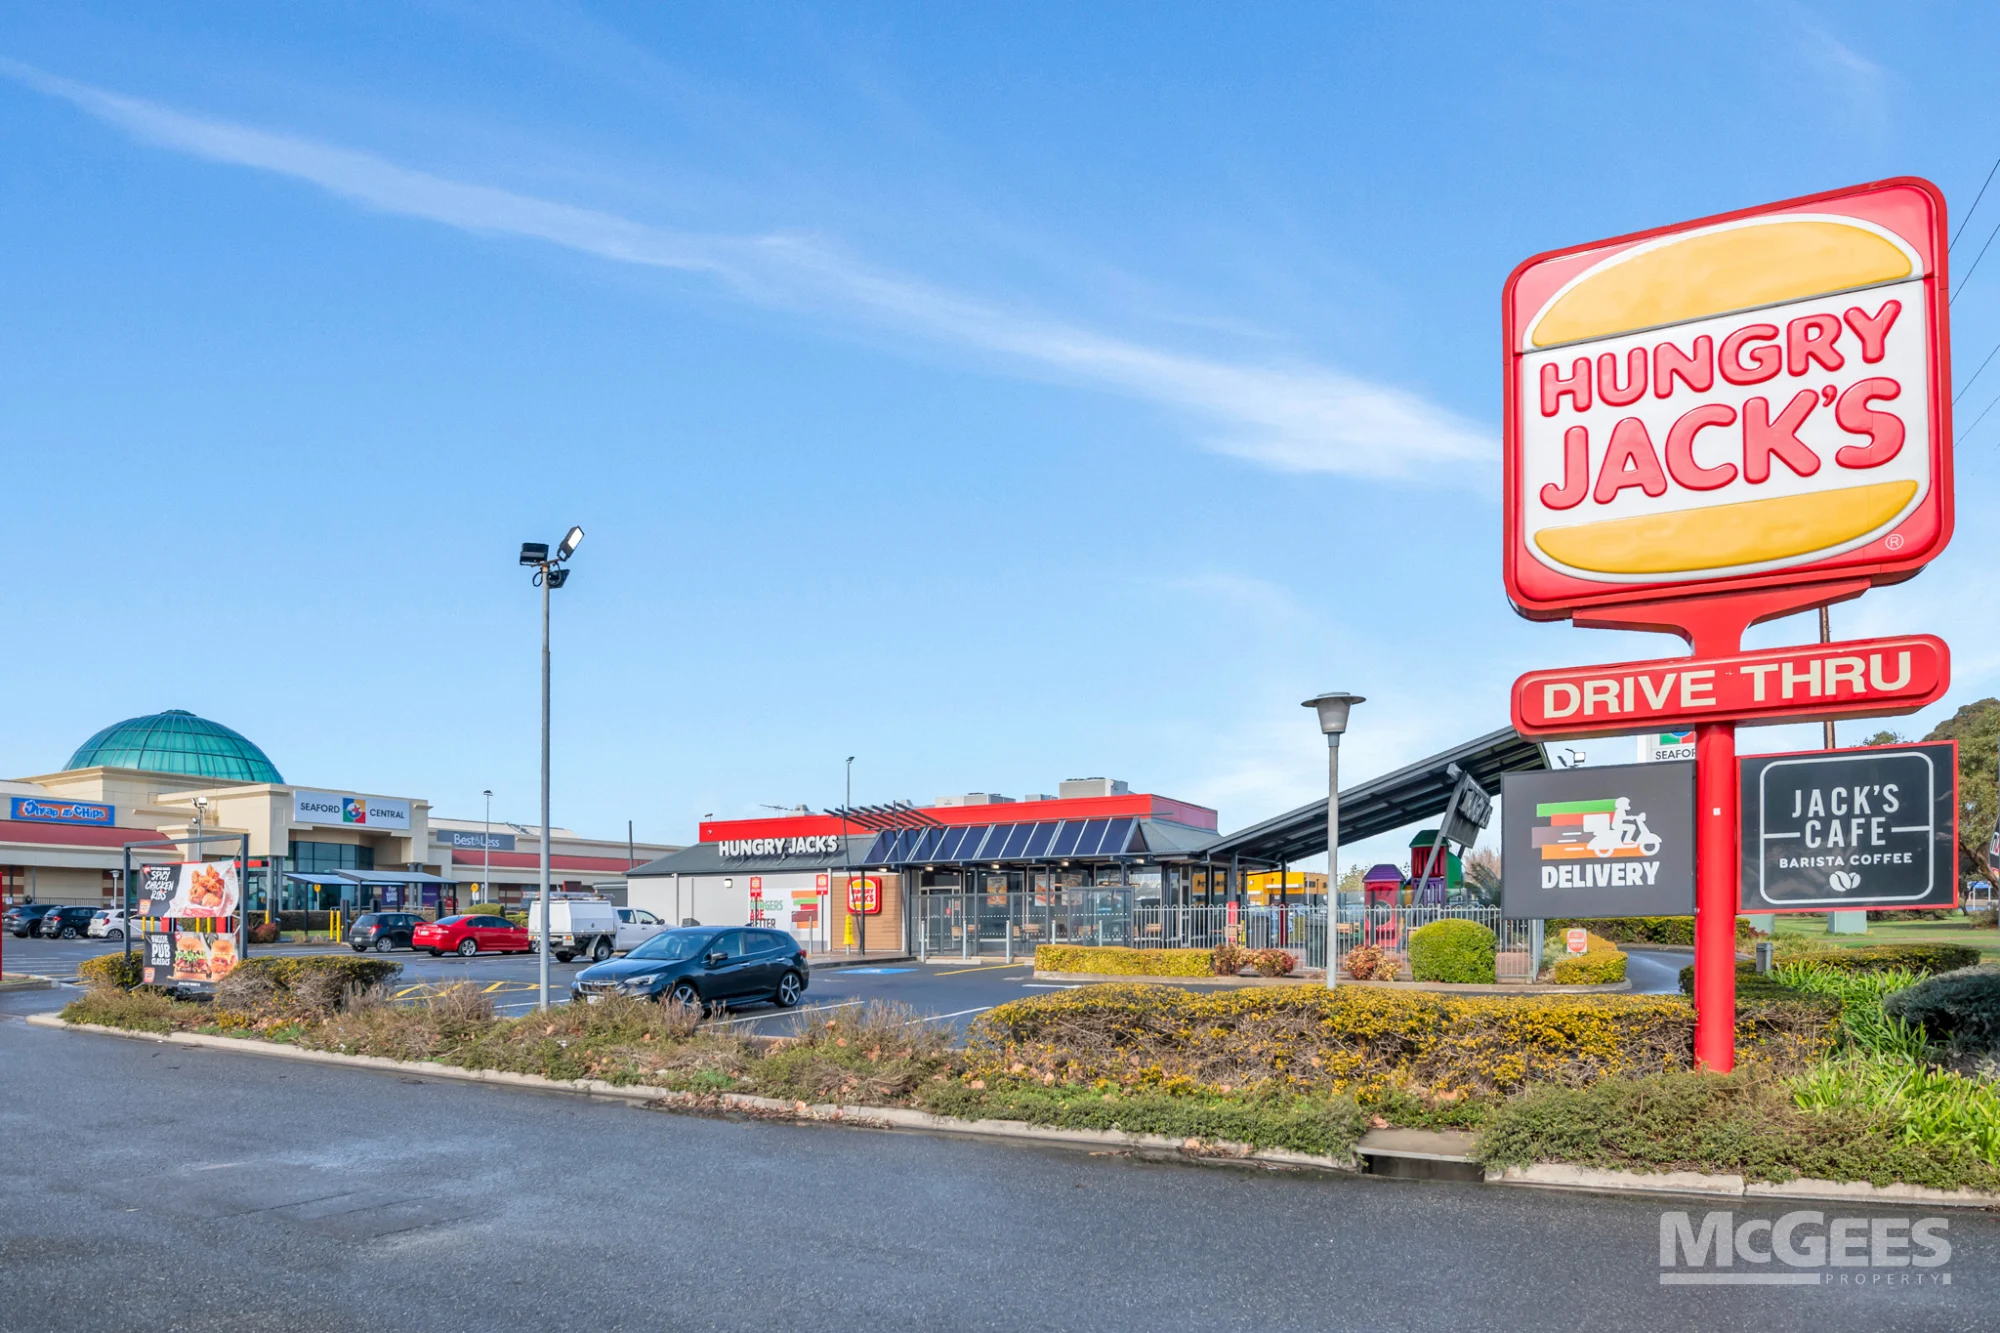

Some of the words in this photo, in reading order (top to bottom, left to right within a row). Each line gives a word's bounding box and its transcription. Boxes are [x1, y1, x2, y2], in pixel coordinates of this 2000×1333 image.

[1540, 300, 1902, 417] HUNGRY
[1540, 378, 1905, 511] JACK'S
[1543, 669, 1716, 719] DRIVE
[1740, 652, 1912, 702] THRU
[1655, 748, 1696, 760] SEAFOR
[1792, 783, 1900, 818] JACK'S
[300, 802, 340, 813] SEAFORD
[369, 808, 404, 819] CENTRAL
[1805, 817, 1886, 848] CAFE
[718, 838, 786, 857] HUNGRY
[788, 835, 839, 854] JACK'S
[1779, 856, 1845, 868] BARISTA
[1850, 852, 1912, 865] COFFEE
[151, 871, 170, 881] SPICY
[1541, 861, 1660, 889] DELIVERY
[145, 880, 174, 891] CHICKEN
[150, 890, 167, 900] RIBS
[152, 943, 171, 958] PUB
[151, 958, 170, 966] CLASSICS
